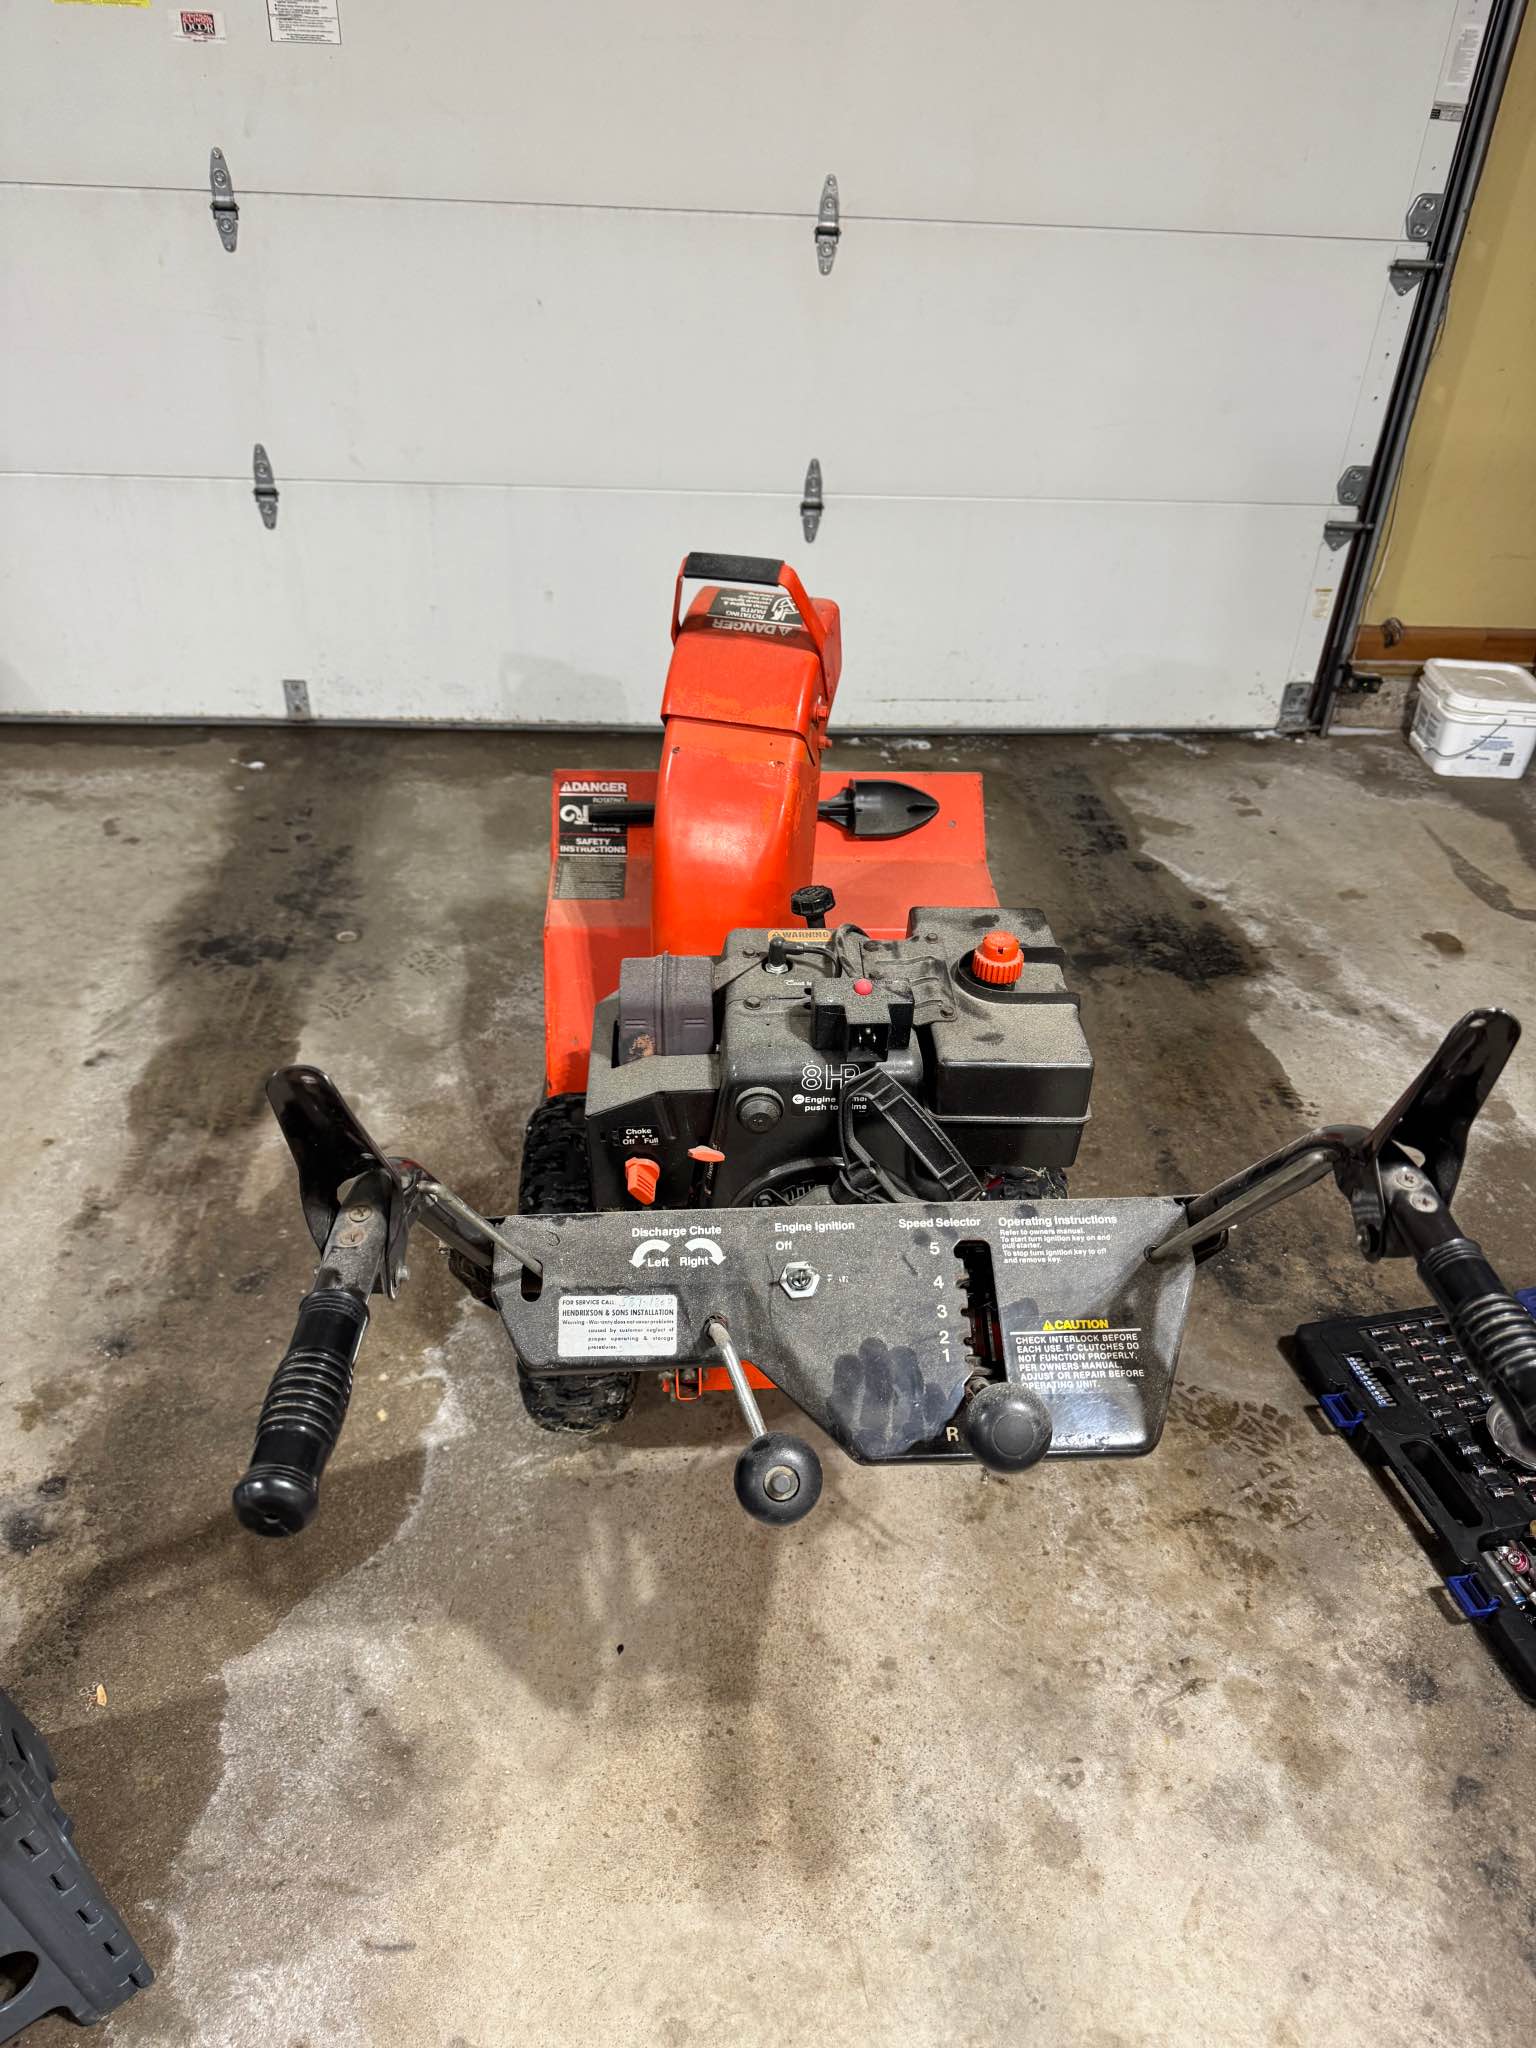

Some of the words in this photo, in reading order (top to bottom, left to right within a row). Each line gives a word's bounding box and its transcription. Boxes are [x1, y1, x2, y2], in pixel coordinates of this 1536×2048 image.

[183, 22, 215, 34] DOOR
[726, 610, 765, 619] ROTATING
[712, 619, 776, 634] DANGER
[572, 782, 628, 792] DANGER
[560, 845, 626, 854] INSTRUCTIONS
[804, 1096, 837, 1104] Engine
[804, 1104, 827, 1112] push
[898, 1218, 934, 1230] Speed
[936, 1218, 981, 1228] Selector
[998, 1216, 1052, 1228] Operating
[1054, 1215, 1118, 1225] Instructions
[632, 1227, 687, 1238] Discharge
[689, 1226, 722, 1235] Chute
[774, 1222, 812, 1234] Engine
[814, 1221, 855, 1233] Ignition
[1044, 1235, 1071, 1243] ignition
[776, 1240, 792, 1250] Off
[930, 1242, 940, 1254] 5
[1002, 1242, 1015, 1250] pull
[1012, 1250, 1028, 1258] stop
[1046, 1248, 1072, 1257] ignition
[1074, 1248, 1087, 1256] key
[648, 1257, 670, 1267] Left
[680, 1256, 709, 1268] Right
[1047, 1256, 1062, 1264] key.
[933, 1274, 944, 1289] 4
[936, 1304, 948, 1318] 3
[1054, 1320, 1108, 1330] CAUTION
[940, 1330, 950, 1344] 2
[1016, 1336, 1048, 1345] CHECK
[1048, 1334, 1100, 1344] INTERLOCK
[1102, 1333, 1138, 1342] BEFORE
[1016, 1346, 1042, 1354] EACH
[1044, 1344, 1064, 1352] USE.
[1066, 1344, 1074, 1352] IF
[1076, 1342, 1124, 1352] CLUTCHES
[1126, 1342, 1140, 1350] DO
[942, 1348, 950, 1362] 1
[1018, 1354, 1037, 1363] NOT
[1040, 1352, 1086, 1362] FUNCTION
[1088, 1352, 1138, 1360] PROPERLY,
[1020, 1364, 1037, 1372] PER
[1040, 1362, 1080, 1371] OWNERS
[1020, 1372, 1055, 1381] ADJUST
[1057, 1372, 1071, 1380] OR
[1072, 1370, 1106, 1378] REPAIR
[1108, 1370, 1145, 1378] BEFORE
[1076, 1380, 1101, 1388] UNIT.
[946, 1426, 960, 1442] R
